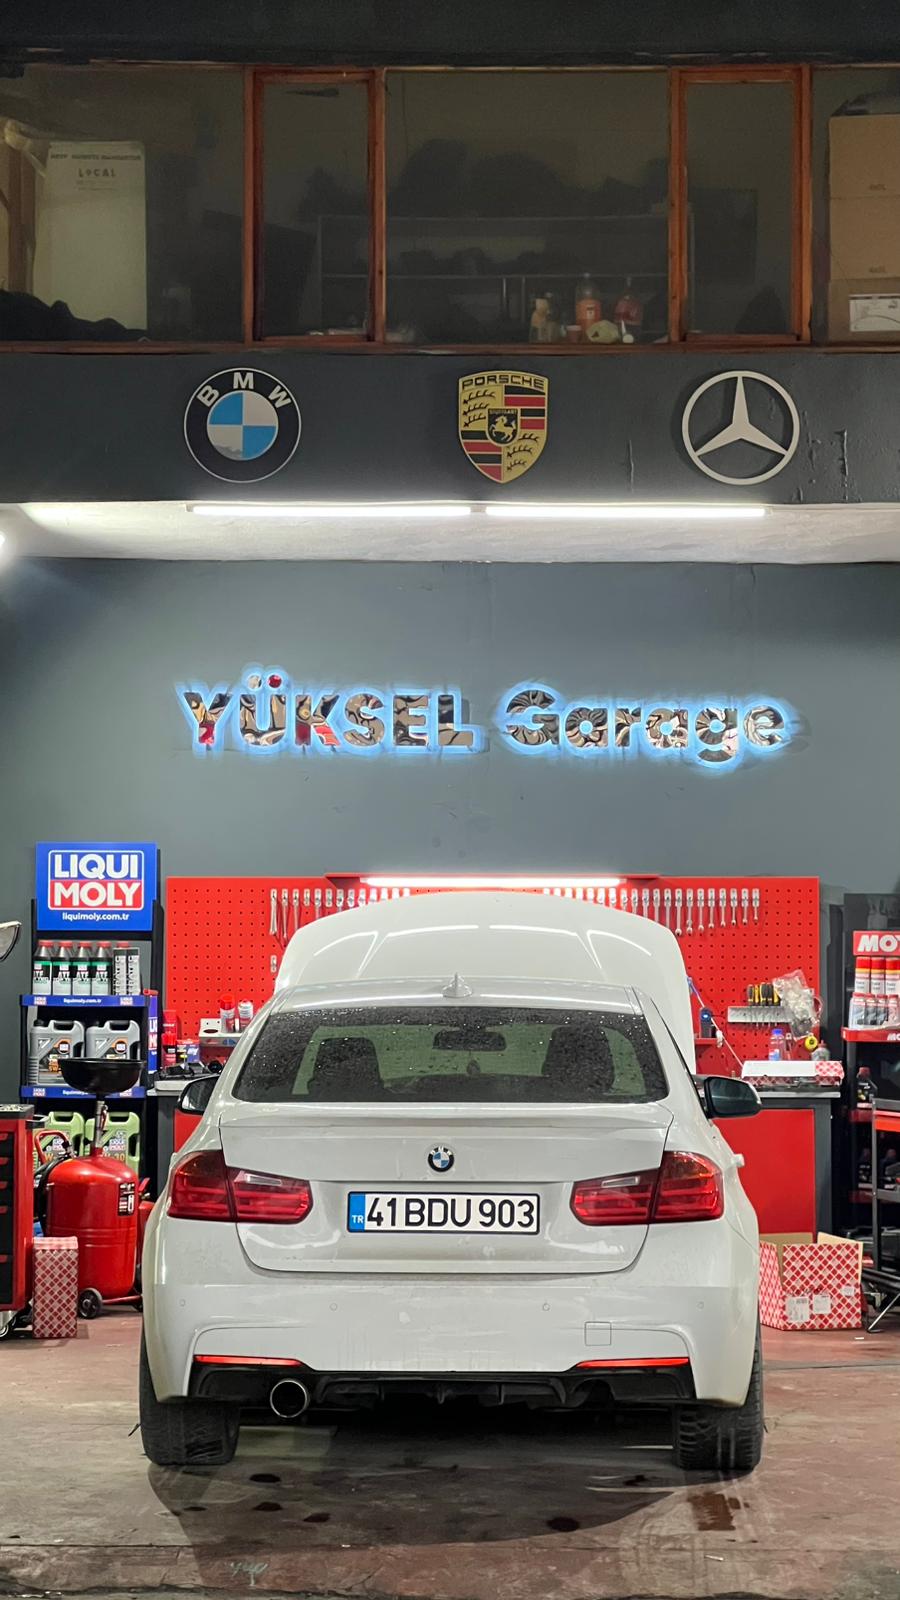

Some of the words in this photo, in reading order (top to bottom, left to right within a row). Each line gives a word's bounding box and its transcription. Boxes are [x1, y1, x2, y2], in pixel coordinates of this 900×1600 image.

[78, 168, 117, 177] LOCAL
[197, 372, 292, 408] BMW
[462, 374, 544, 390] PORSCHE
[181, 673, 476, 747] YÜKSEL
[503, 687, 787, 763] Garage
[54, 853, 139, 880] LIQUI
[54, 881, 141, 907] MOLY
[62, 911, 130, 922] liquimoly.com.tr
[351, 1214, 364, 1224] TR
[367, 1197, 397, 1227] 41
[404, 1198, 472, 1228] BDU
[478, 1198, 535, 1228] 903
